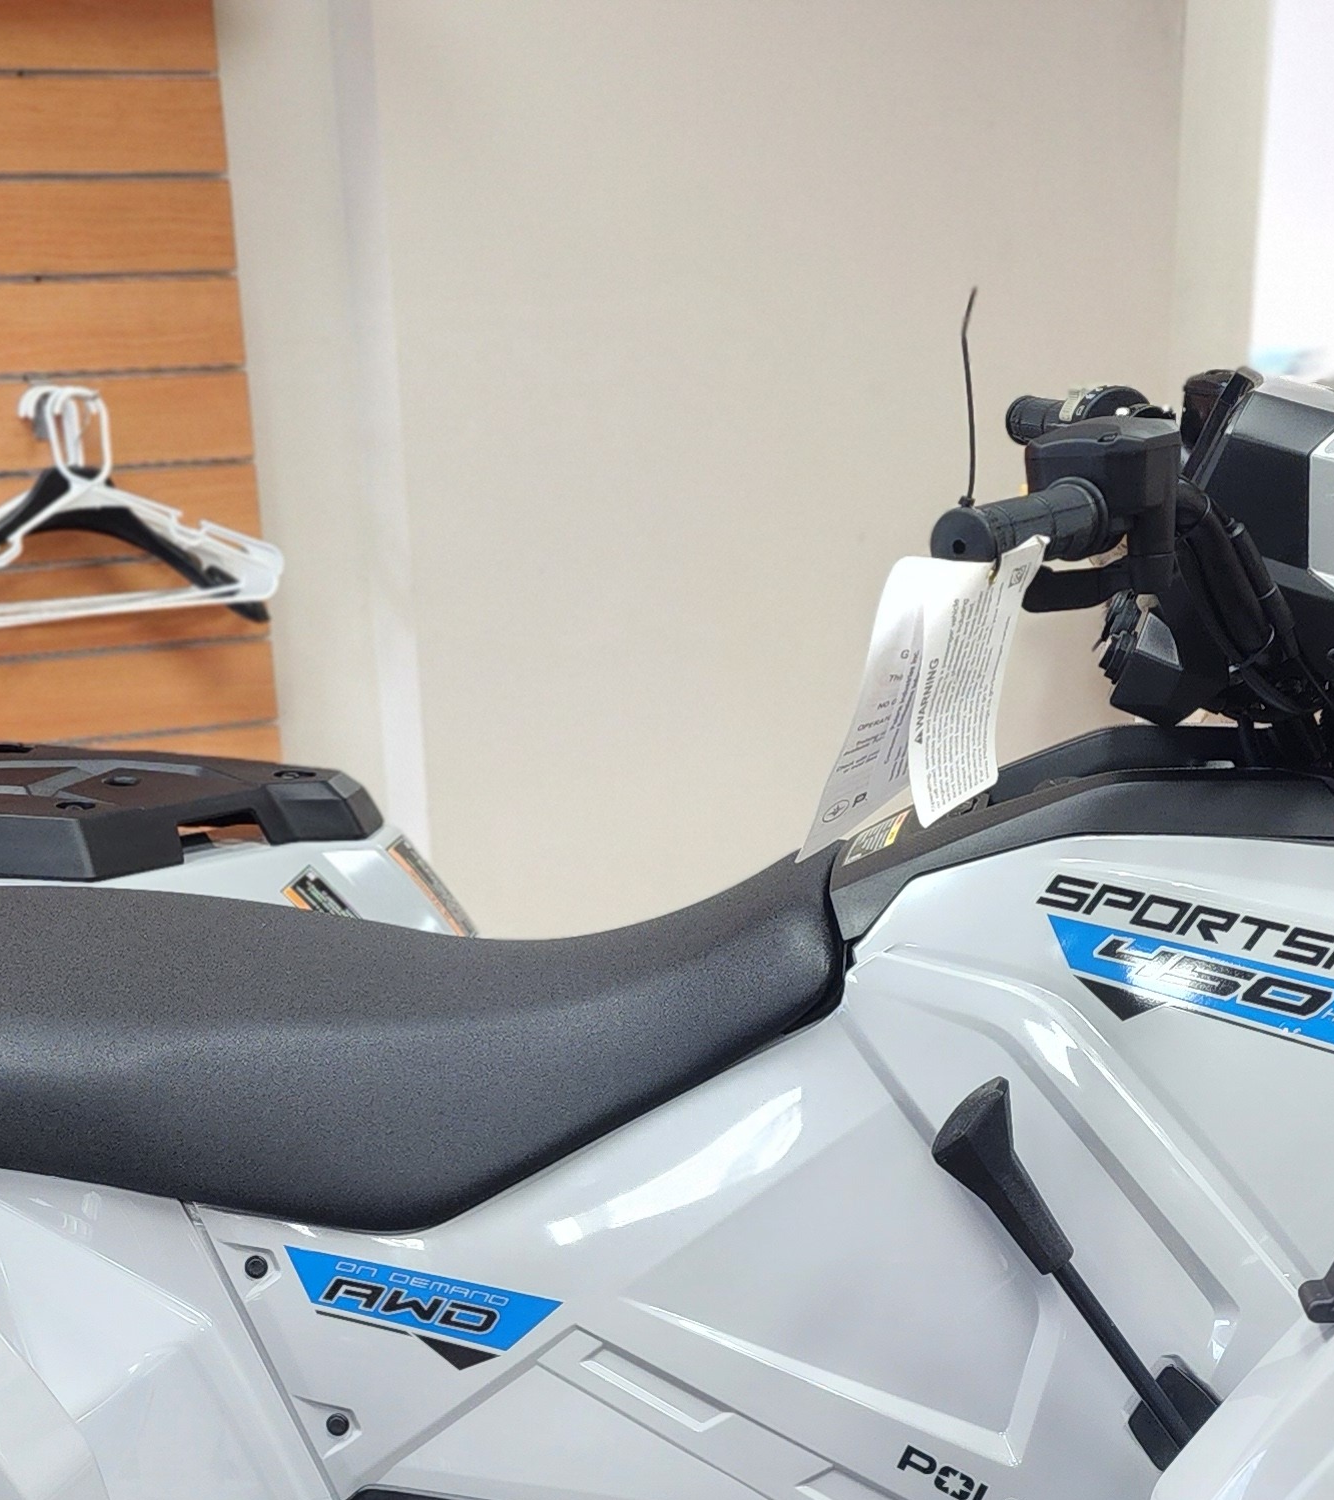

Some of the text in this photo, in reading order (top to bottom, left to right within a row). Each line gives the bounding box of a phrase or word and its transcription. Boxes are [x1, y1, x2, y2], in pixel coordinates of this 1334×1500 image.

[917, 658, 940, 734] WARNING
[1094, 935, 1334, 1020] 450
[319, 1277, 502, 1336] AWD
[335, 1261, 511, 1307] ON DEMAND
